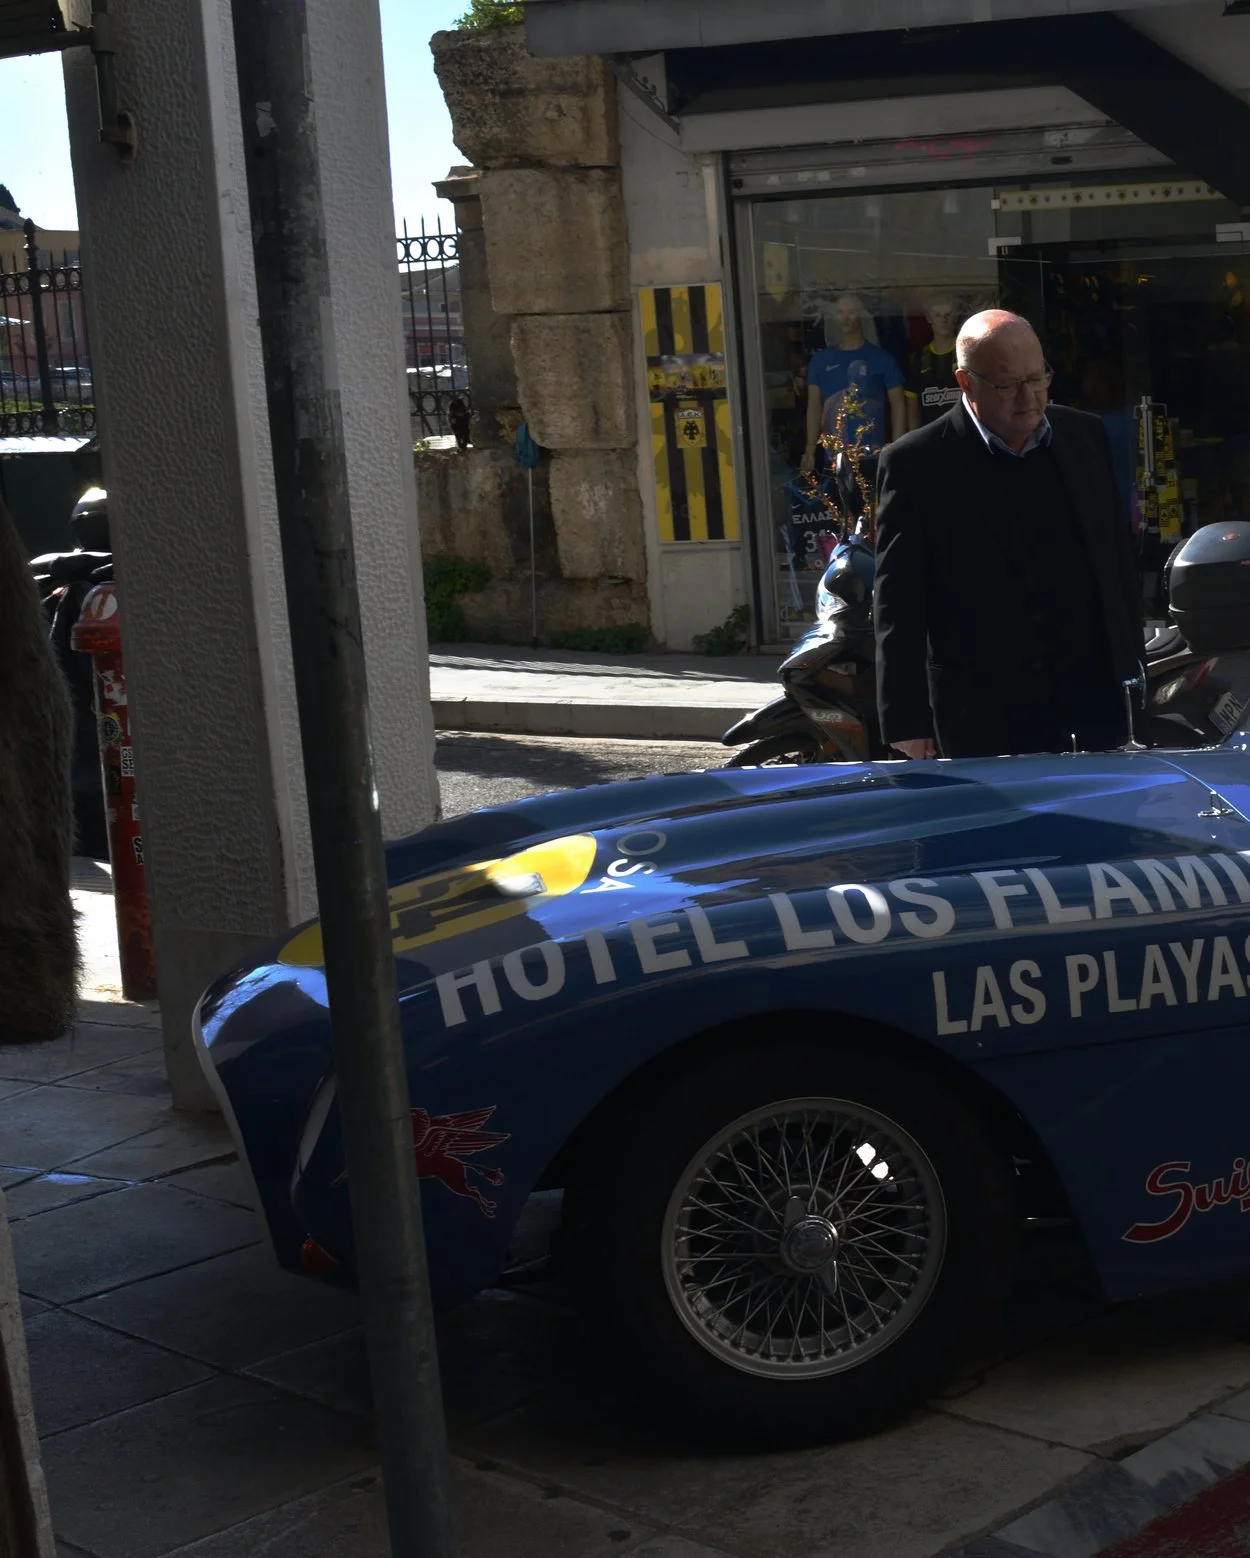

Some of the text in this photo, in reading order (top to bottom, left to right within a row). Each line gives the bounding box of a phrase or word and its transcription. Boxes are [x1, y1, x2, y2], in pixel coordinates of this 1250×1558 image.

[435, 907, 751, 1028] HOTEL
[770, 876, 956, 951] LOS
[932, 959, 1047, 1036] LAS
